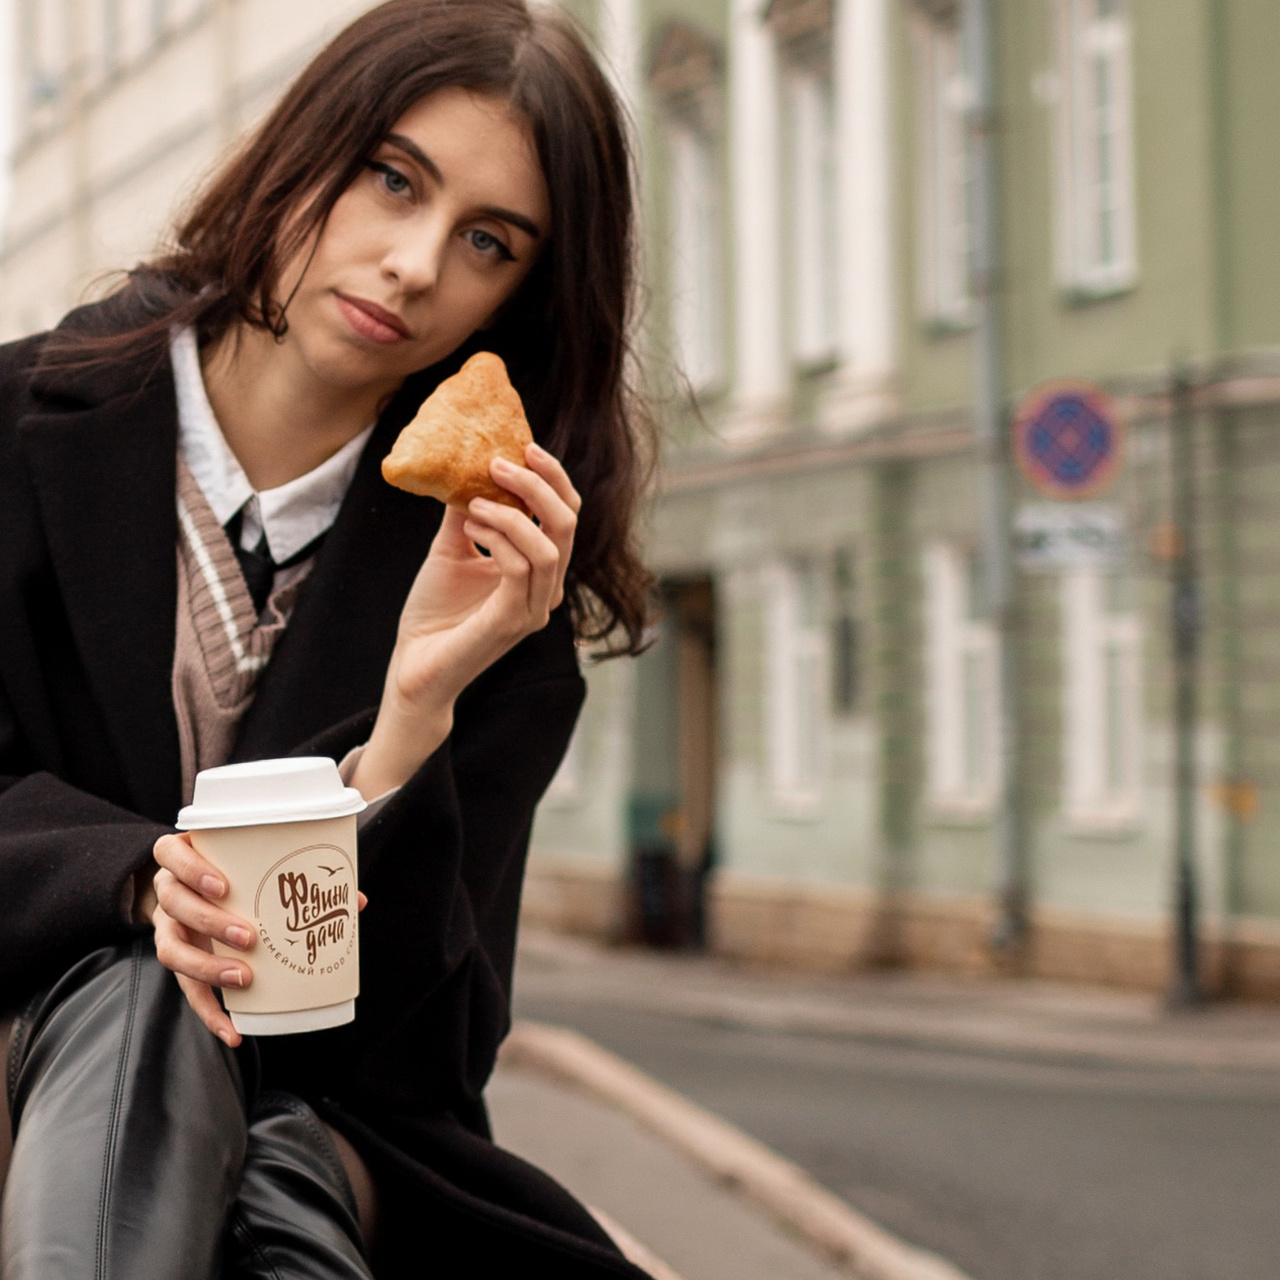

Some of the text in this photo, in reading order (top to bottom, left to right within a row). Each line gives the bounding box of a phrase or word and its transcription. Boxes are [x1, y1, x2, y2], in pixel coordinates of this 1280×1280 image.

[278, 872, 349, 931] Федина
[260, 928, 314, 975] СЕМЕЙНЫЙ
[320, 957, 345, 975] FOOD
[306, 919, 344, 965] дача
